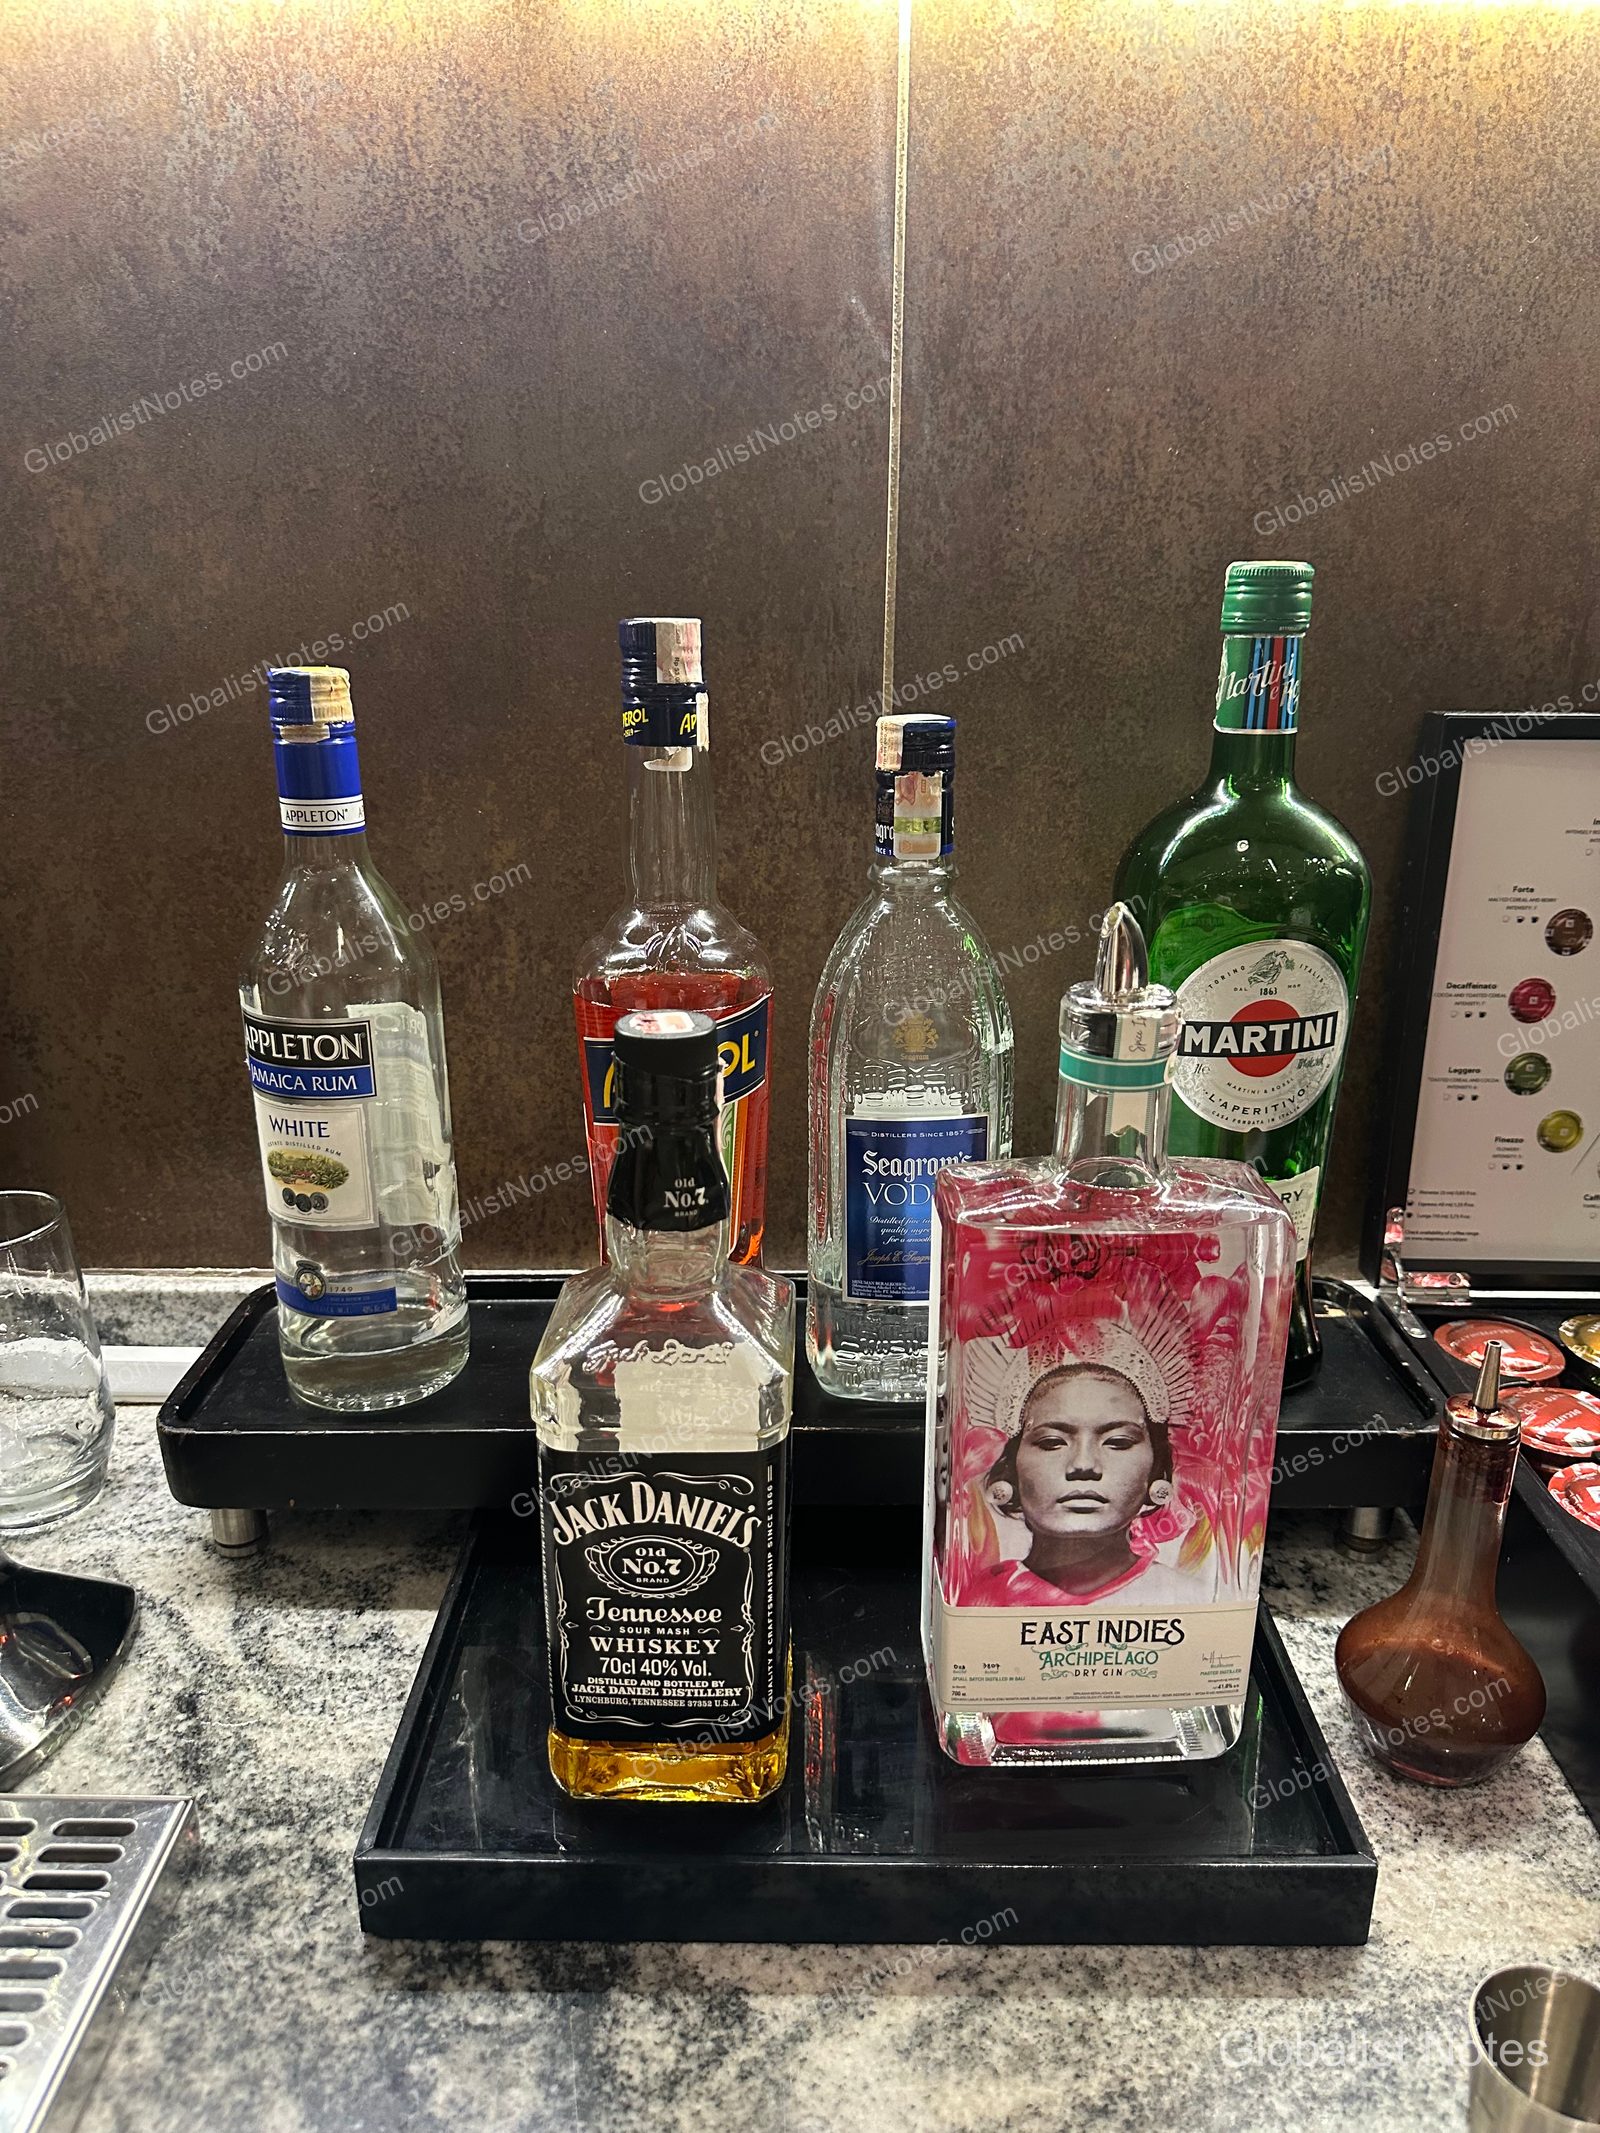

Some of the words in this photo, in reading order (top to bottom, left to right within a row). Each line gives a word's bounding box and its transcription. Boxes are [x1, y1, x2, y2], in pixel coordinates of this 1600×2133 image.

[286, 809, 346, 822] APPLETON
[1512, 885, 1534, 893] Forte
[1208, 965, 1246, 989] TORINO
[1260, 987, 1278, 996] 1863
[1446, 982, 1497, 990] Decaffeinato
[245, 1022, 362, 1061] APPLETON
[1183, 1016, 1334, 1054] MARTINI
[1448, 1067, 1481, 1075] Leggero
[251, 1066, 306, 1091] JAMAICA
[312, 1075, 358, 1092] RUM
[1227, 1081, 1260, 1095] MARTINI
[1208, 1088, 1306, 1116] L'APERITIVO
[1211, 1110, 1229, 1121] CASA
[1232, 1117, 1264, 1125] FONDATA
[269, 1115, 330, 1138] WHITE
[325, 1148, 342, 1157] RUM
[675, 1177, 695, 1188] Old
[664, 1187, 707, 1208] No.7
[862, 1182, 936, 1206] VOD
[1281, 1189, 1303, 1203] RY
[550, 1492, 630, 1545] JACK
[630, 1481, 763, 1548] DANIEL'S
[635, 1547, 666, 1557] Old
[622, 1558, 682, 1575] No.7
[586, 1597, 722, 1623] Tennessee
[619, 1626, 651, 1634] SOUR
[657, 1627, 690, 1635] MASH
[1020, 1620, 1090, 1645] EAST
[1097, 1618, 1185, 1646] INDIES
[589, 1636, 721, 1655] WHISKEY
[599, 1657, 636, 1675] 70cl
[640, 1659, 678, 1677] 40%
[682, 1660, 712, 1677] Vol.
[1039, 1650, 1159, 1671] ARCHIPELAGO
[1075, 1669, 1096, 1677] DRY
[1103, 1668, 1123, 1677] GIN
[588, 1677, 638, 1687] DISTILLED
[640, 1678, 661, 1687] AND
[664, 1679, 709, 1688] BOTTLED
[711, 1680, 725, 1688] BY
[572, 1684, 606, 1694] JACK
[609, 1685, 659, 1696] DANIEL
[662, 1687, 743, 1697] DISTILLERY
[632, 1699, 686, 1707] TENNESSEE
